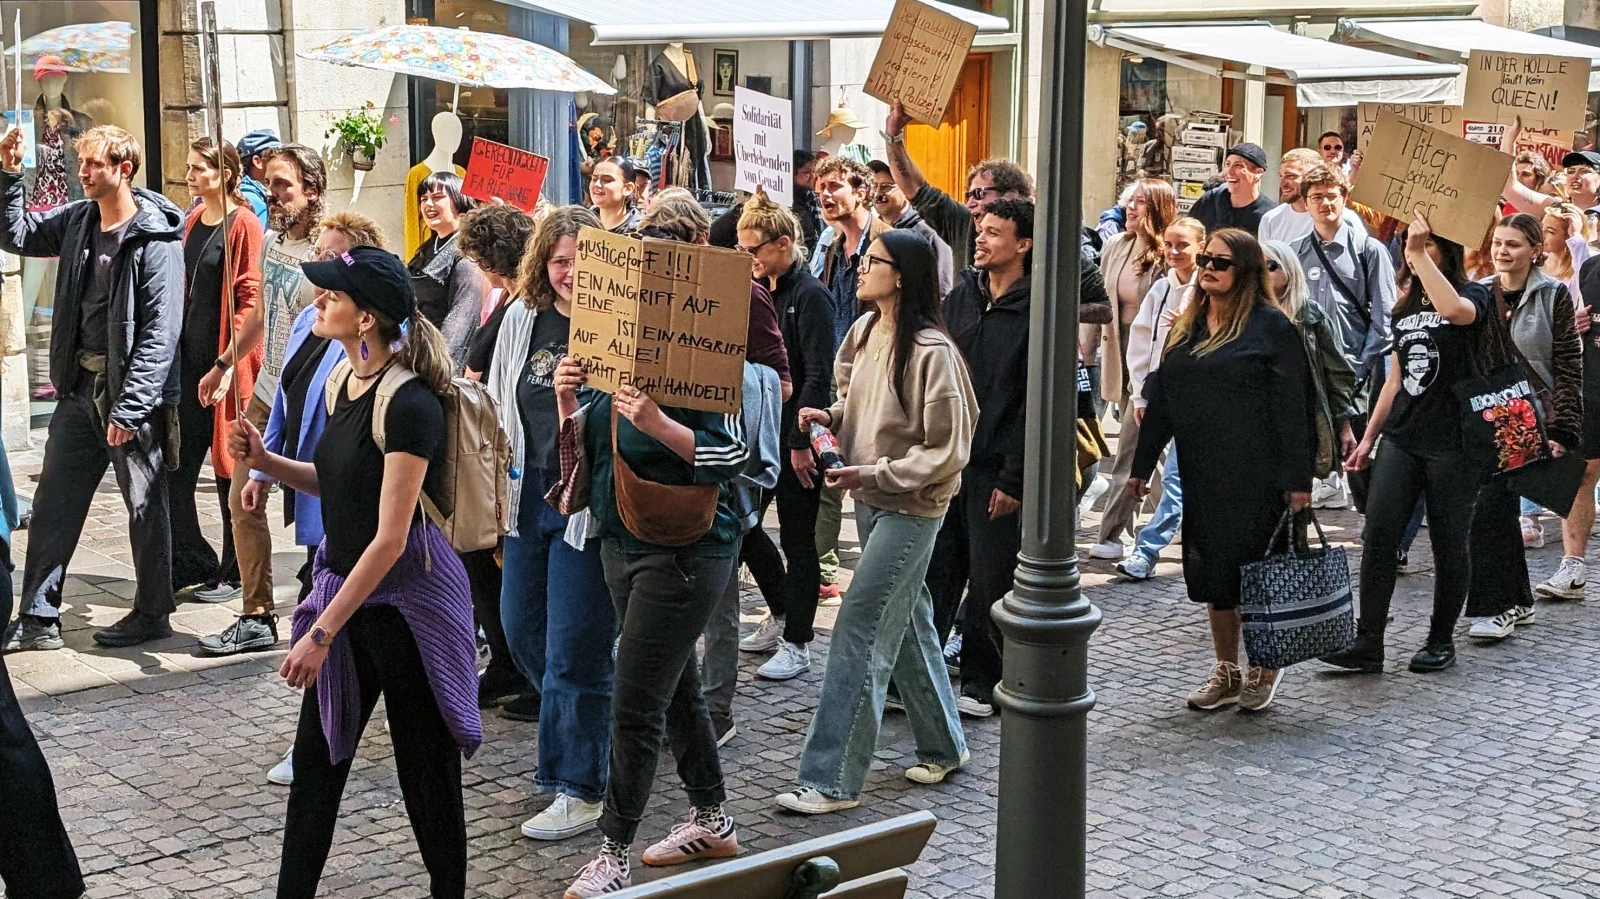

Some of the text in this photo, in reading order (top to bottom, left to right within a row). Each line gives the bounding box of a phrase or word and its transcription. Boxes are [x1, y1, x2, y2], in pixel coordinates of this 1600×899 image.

[904, 52, 928, 67] statt
[1480, 55, 1569, 75] IN DER HÖLLE
[1491, 87, 1559, 111] QUEEN!
[741, 103, 782, 130] Solidarität
[754, 130, 767, 148] mit
[1398, 120, 1458, 174] Täter
[736, 140, 791, 173] Überlebenden
[492, 164, 514, 181] FÜR
[743, 170, 784, 193] von Gewalt
[1407, 169, 1459, 199] schützen
[1379, 173, 1439, 221] Täter
[577, 271, 720, 316] EIN ANGRIFF AUF
[573, 328, 661, 364] AUF ALLE!
[617, 319, 746, 356] IST EIN ANGRIFF
[664, 378, 736, 406] HANDELT!
